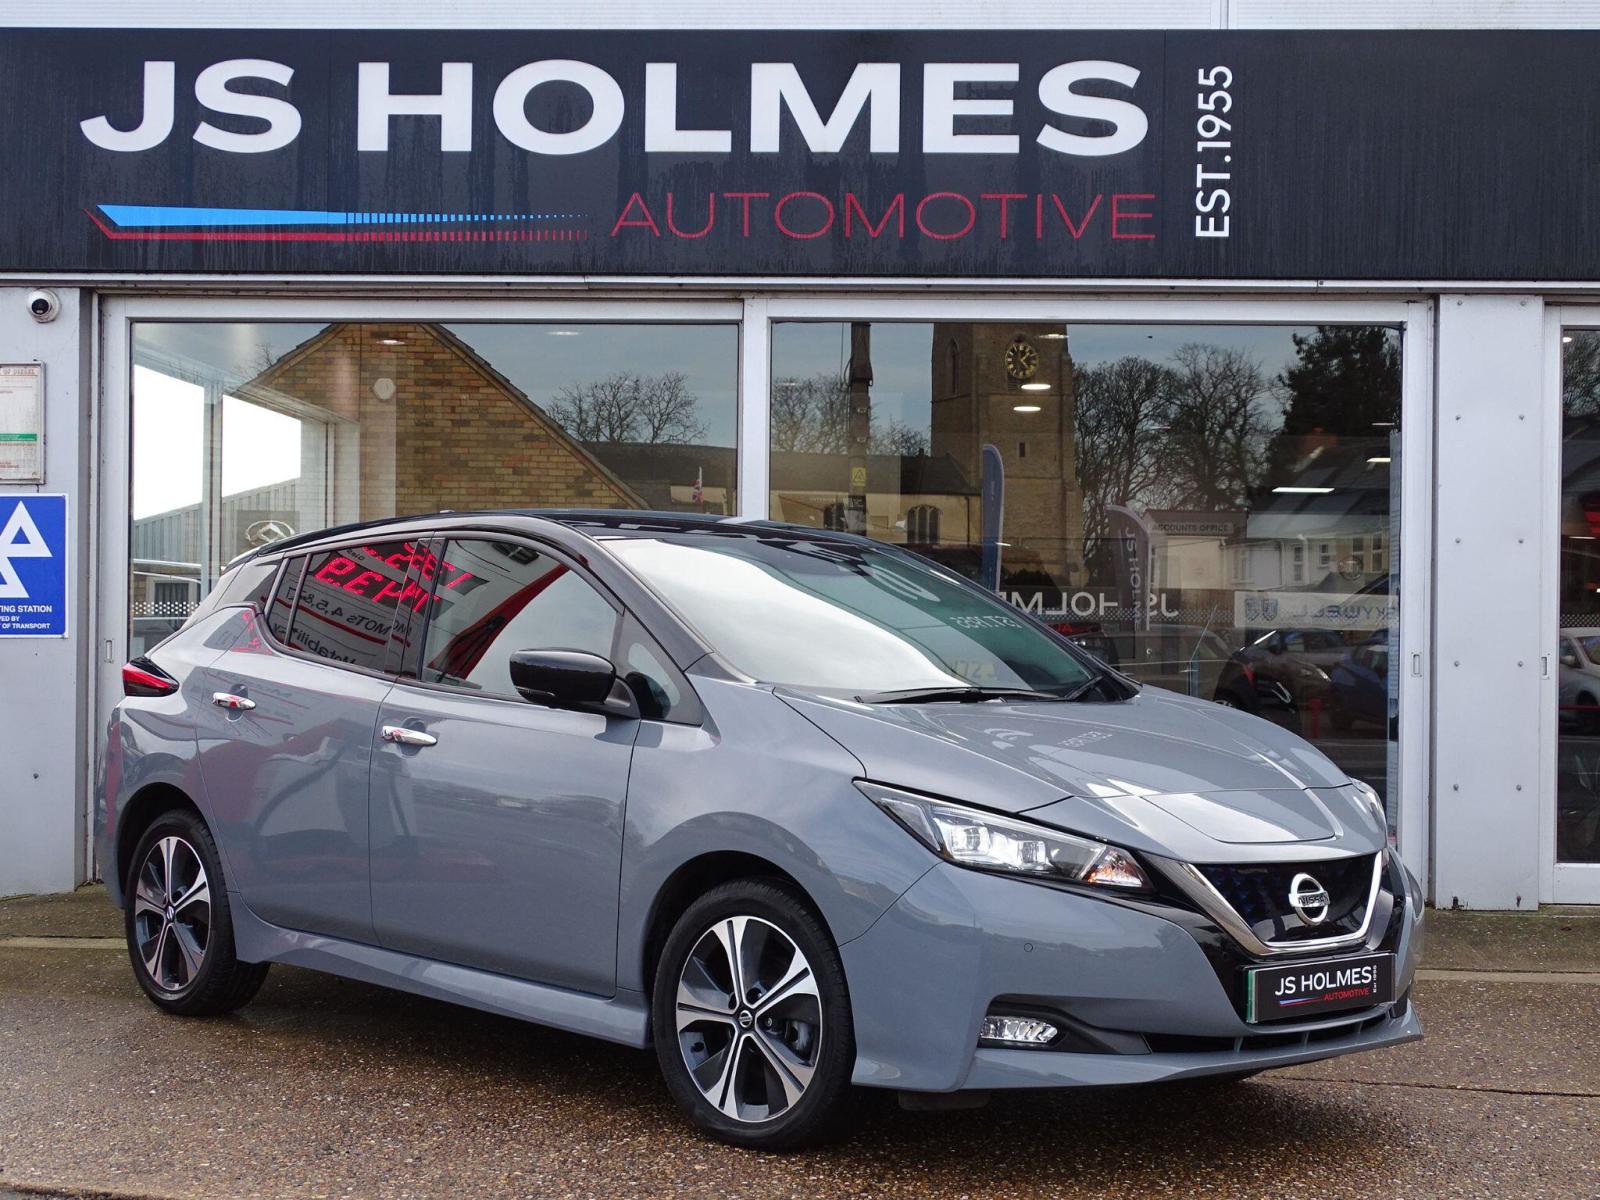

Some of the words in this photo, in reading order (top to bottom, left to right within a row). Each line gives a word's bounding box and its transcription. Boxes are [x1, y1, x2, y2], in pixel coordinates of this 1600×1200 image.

[80, 58, 302, 153] JS
[357, 59, 1149, 157] HOLMES
[1194, 65, 1233, 238] EST.1955
[611, 190, 1156, 241] AUTOMOTIVE
[1199, 523, 1228, 532] OFFICE
[17, 604, 52, 613] STATION
[1275, 976, 1296, 995] JS
[1301, 966, 1372, 992] HOLMES
[1324, 987, 1370, 1001] AUTOMOTIVE
